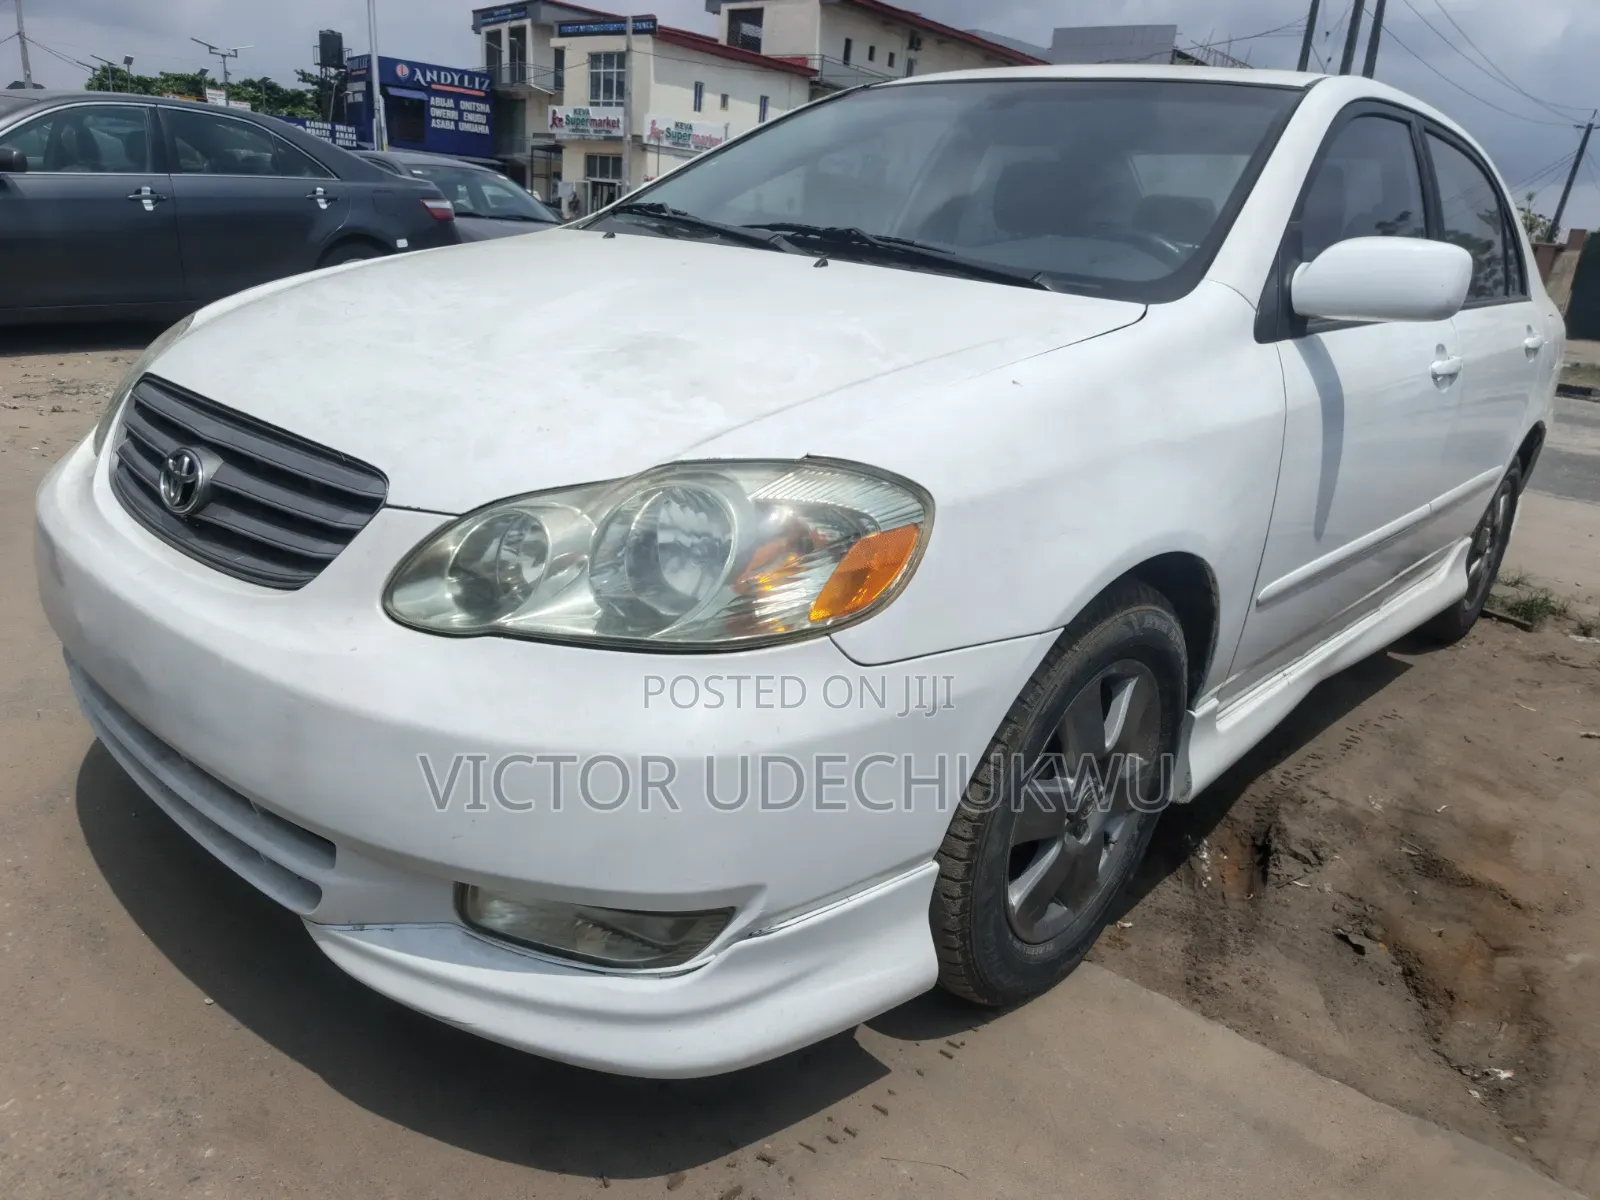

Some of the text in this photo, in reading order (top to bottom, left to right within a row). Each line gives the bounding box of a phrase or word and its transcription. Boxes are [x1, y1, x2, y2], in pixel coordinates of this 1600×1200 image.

[413, 67, 491, 92] ANDYLIZ
[430, 96, 491, 114] ABUJA ONITSHA
[573, 108, 591, 116] KEVA
[430, 107, 487, 124] OWERRI ENUGU
[565, 114, 621, 129] Supermarket
[431, 118, 491, 135] ASABA UMUAHIA
[674, 121, 693, 131] KEVA
